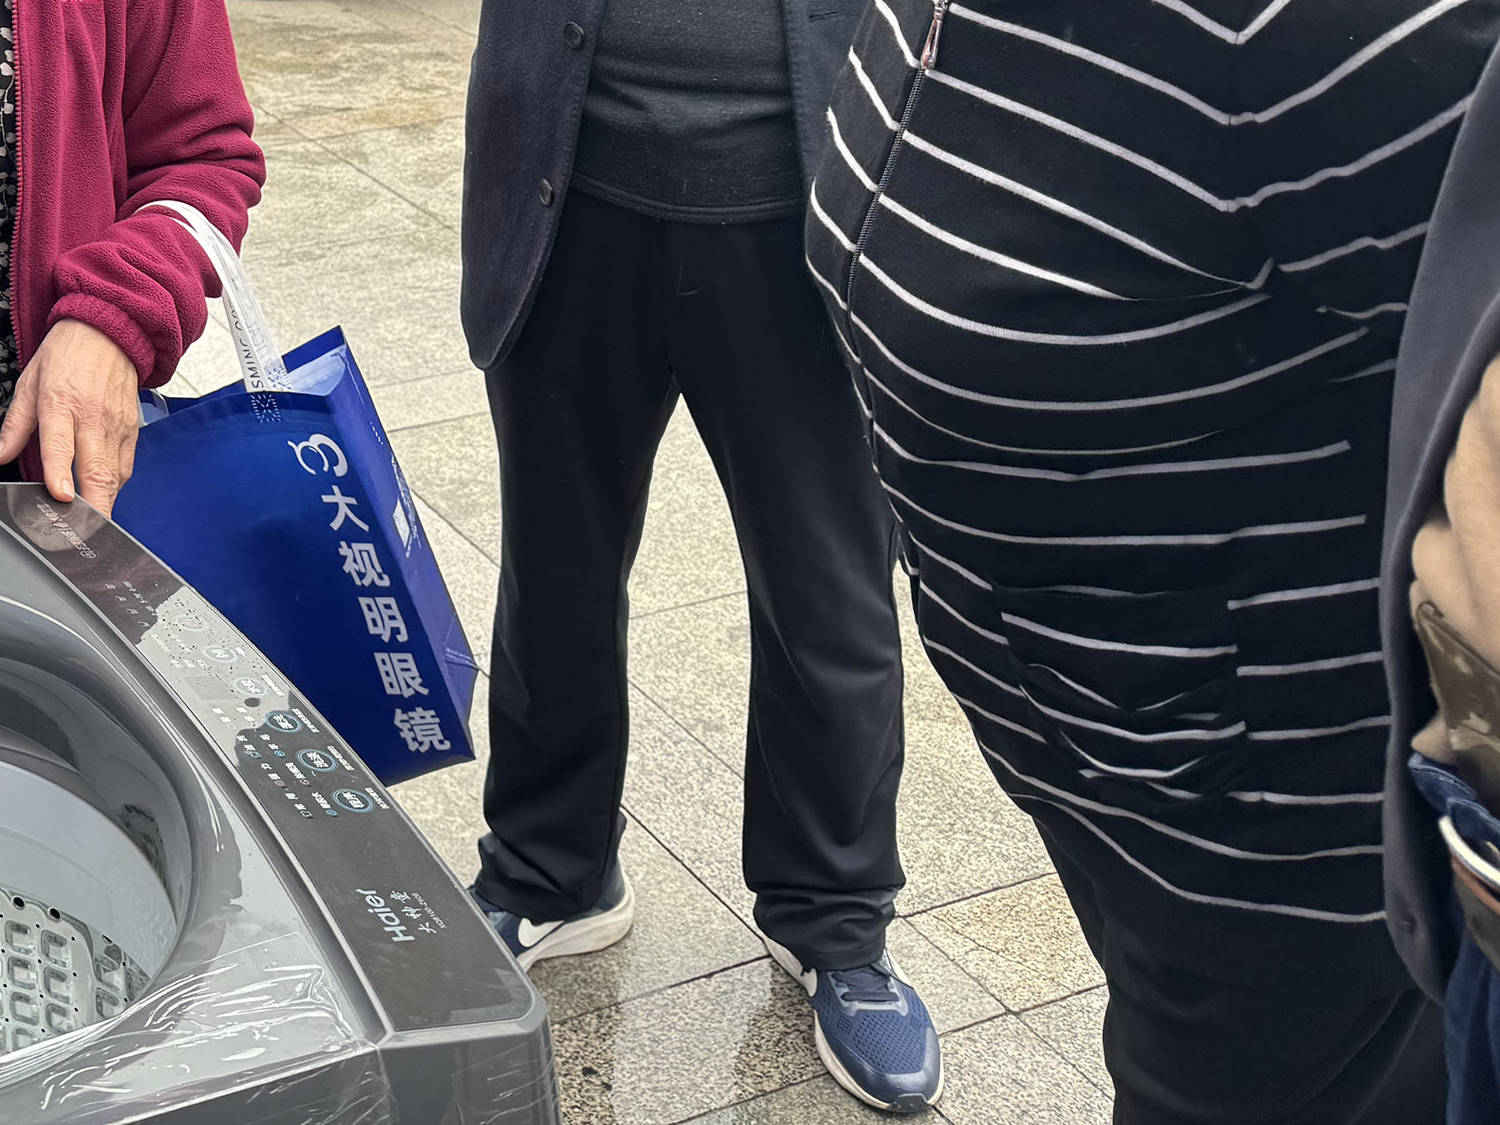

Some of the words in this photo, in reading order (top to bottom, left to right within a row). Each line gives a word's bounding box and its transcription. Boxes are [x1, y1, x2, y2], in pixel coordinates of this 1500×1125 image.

[321, 485, 451, 754] 大视明眼镜
[356, 888, 415, 942] Haier
